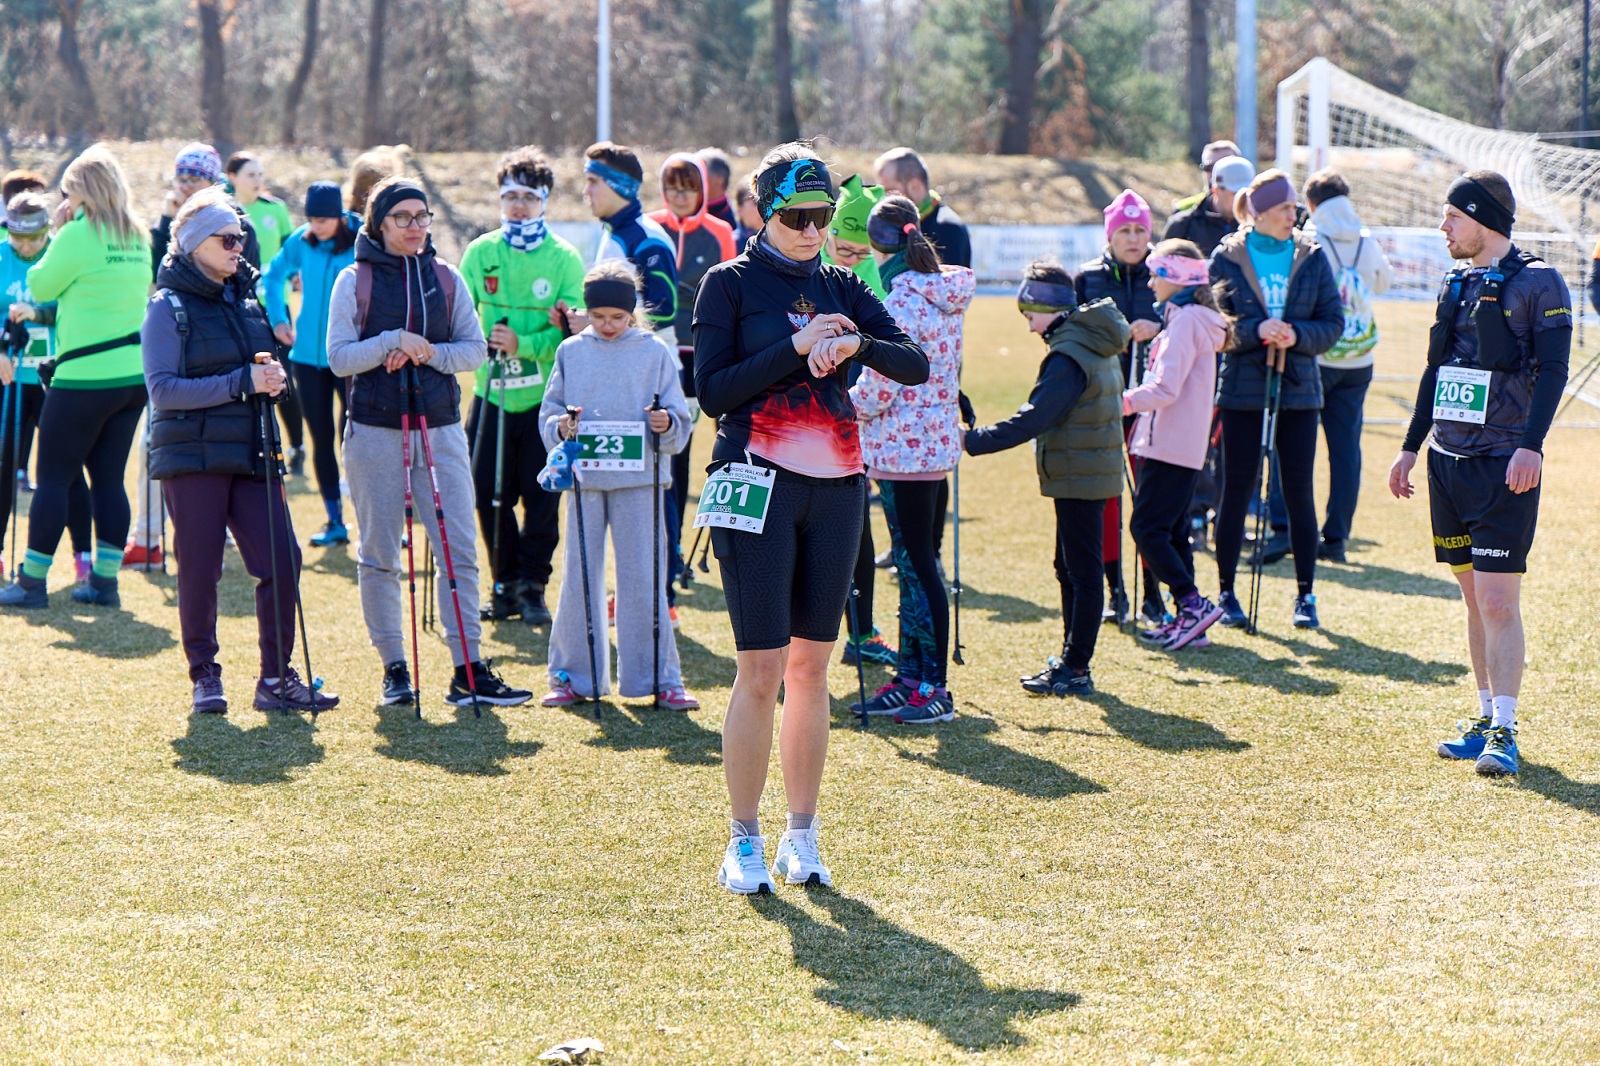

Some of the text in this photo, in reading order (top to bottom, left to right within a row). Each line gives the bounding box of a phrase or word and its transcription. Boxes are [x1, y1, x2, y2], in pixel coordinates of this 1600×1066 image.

[842, 216, 868, 232] Spri
[1438, 381, 1475, 404] 206
[594, 435, 624, 453] 23
[744, 469, 765, 477] WALKIN
[703, 481, 751, 507] 201
